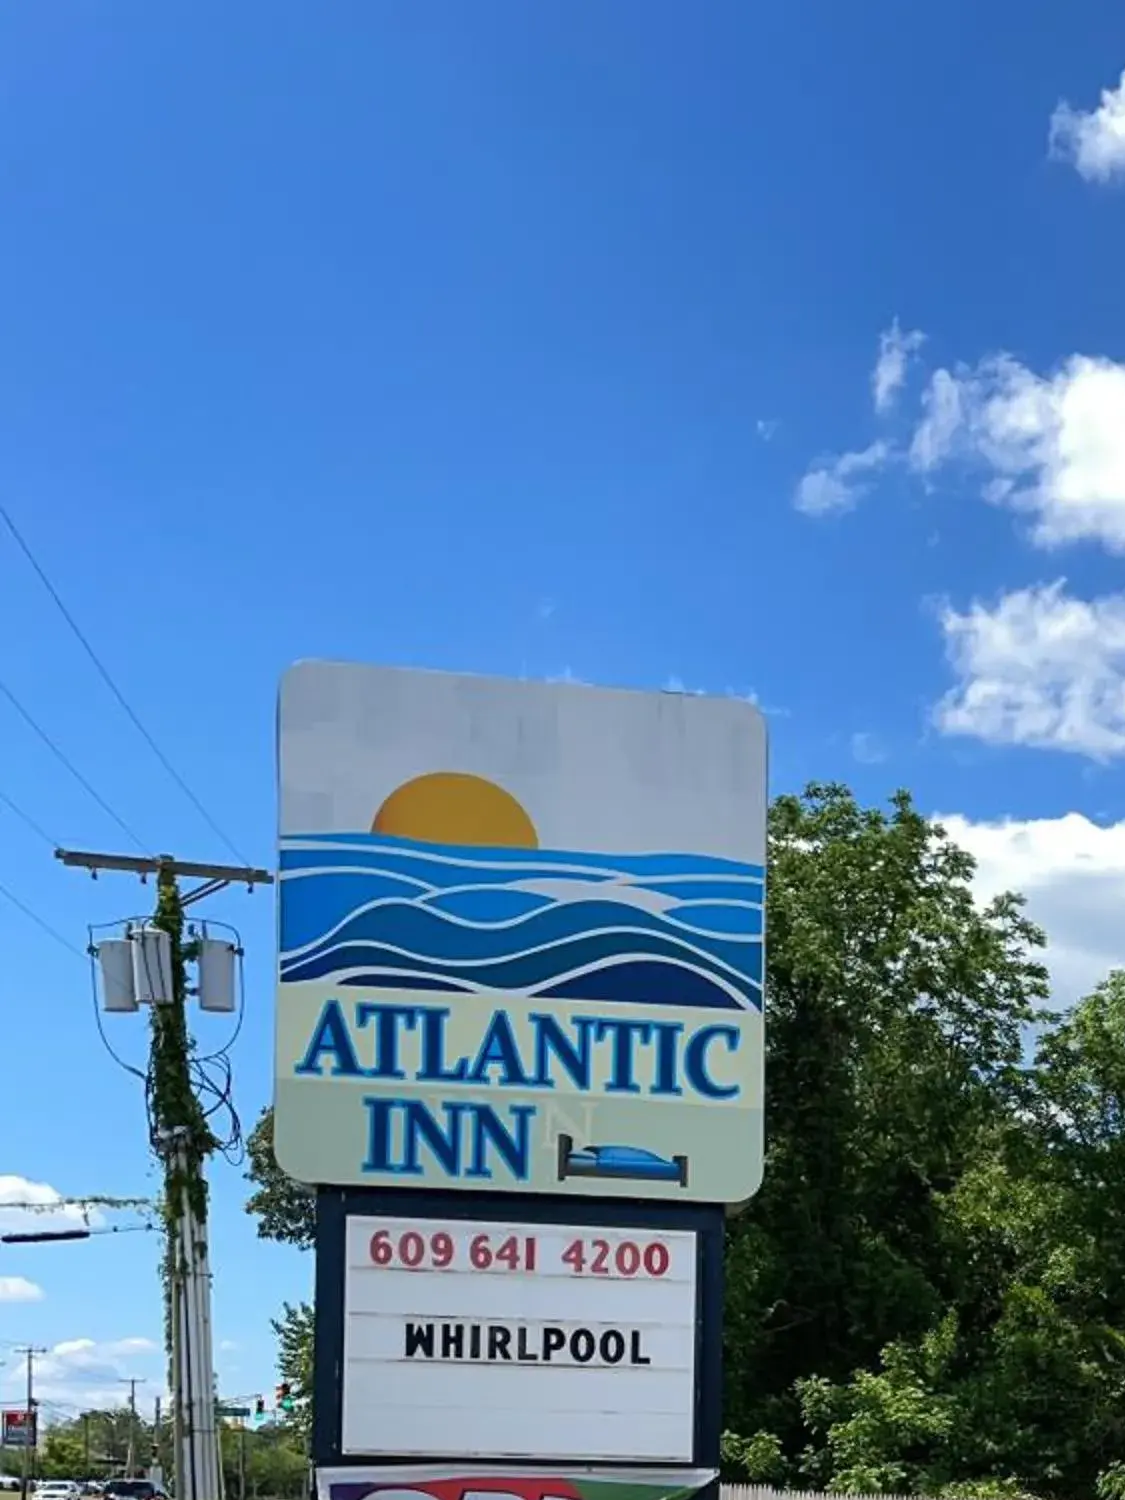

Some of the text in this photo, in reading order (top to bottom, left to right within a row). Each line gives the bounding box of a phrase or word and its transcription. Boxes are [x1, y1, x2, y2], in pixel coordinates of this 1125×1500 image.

[294, 999, 741, 1099] ATLANTIC
[361, 1096, 537, 1180] INN
[369, 1230, 670, 1276] 609 641 4200
[404, 1322, 652, 1365] WHIRLPOOL
